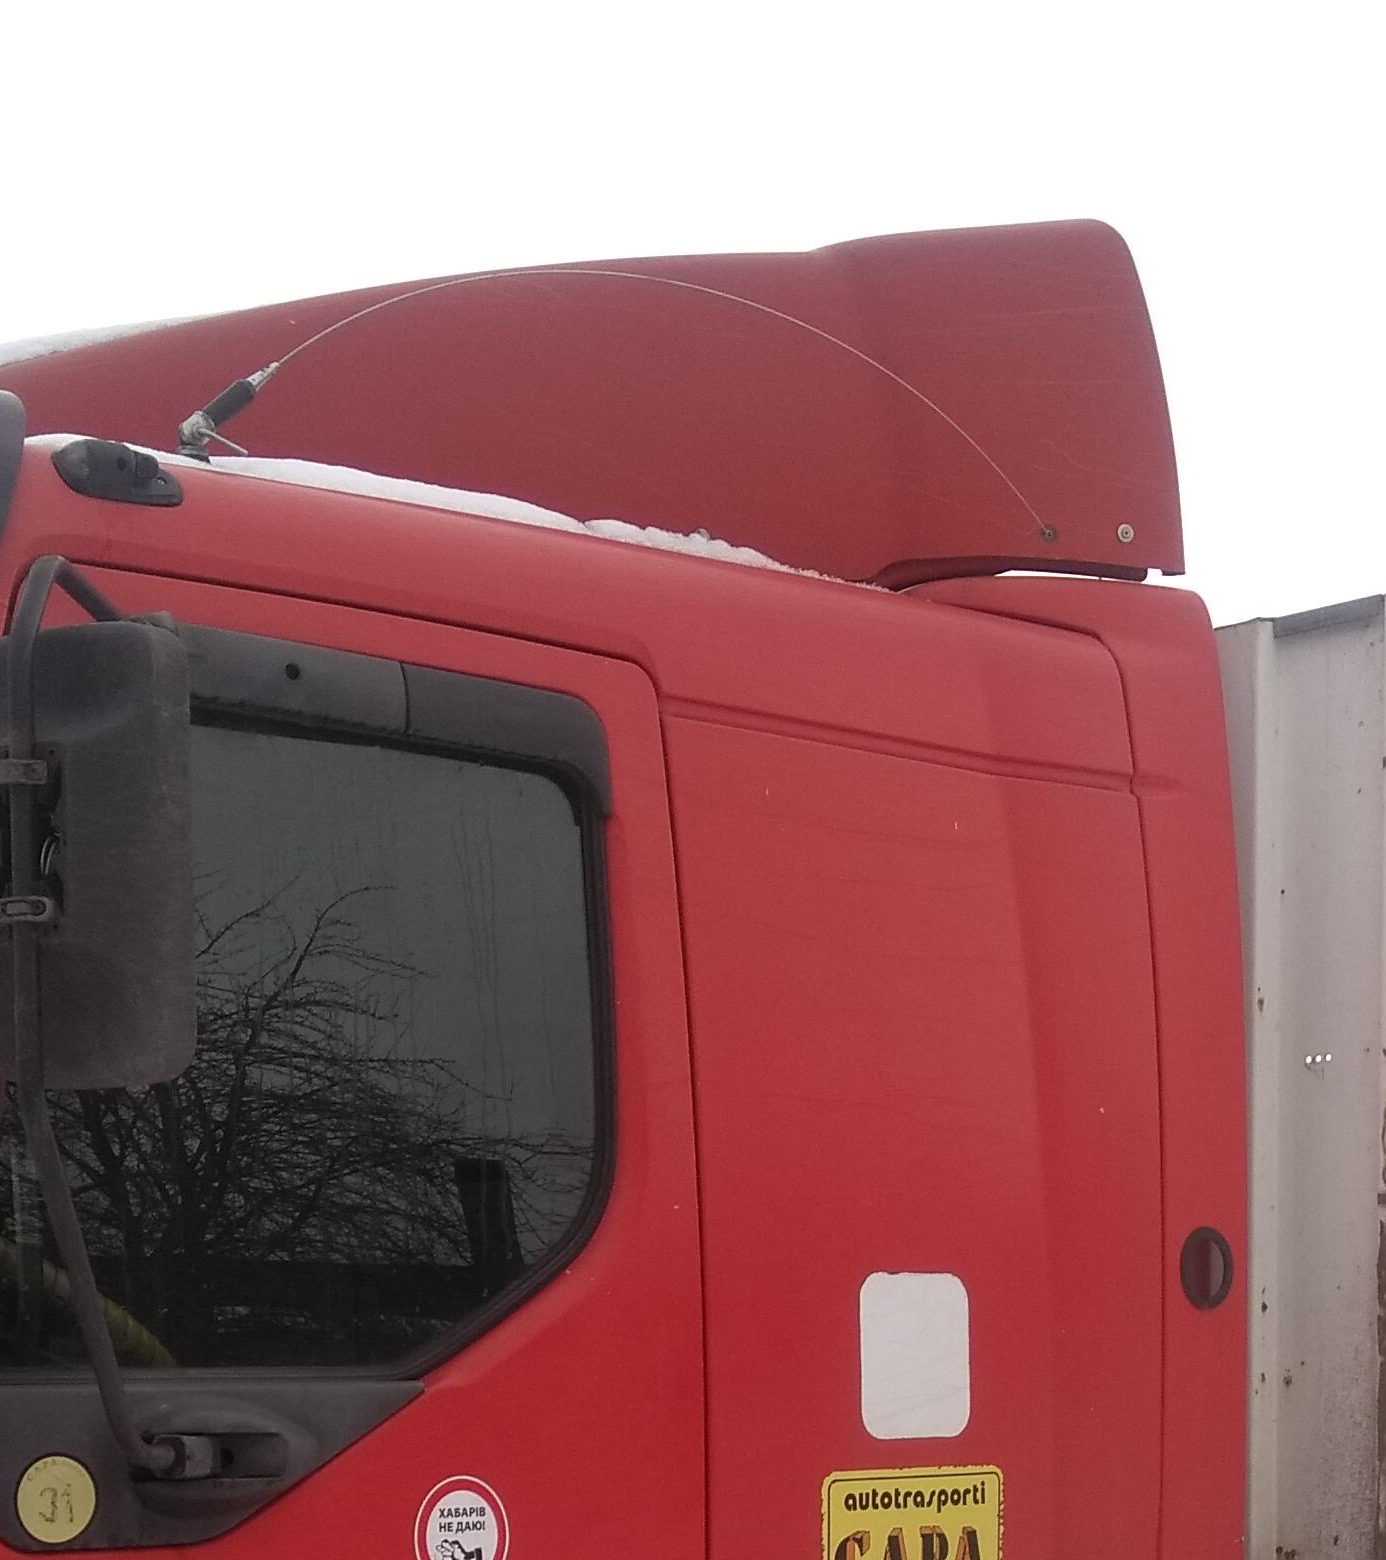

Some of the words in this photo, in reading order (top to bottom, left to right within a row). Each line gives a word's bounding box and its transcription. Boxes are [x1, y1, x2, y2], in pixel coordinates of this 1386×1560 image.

[844, 1481, 986, 1513] autotrasporti
[438, 1507, 486, 1519] ХАБАРІВ
[439, 1522, 454, 1532] НЕ
[455, 1521, 486, 1534] ДАЮ!
